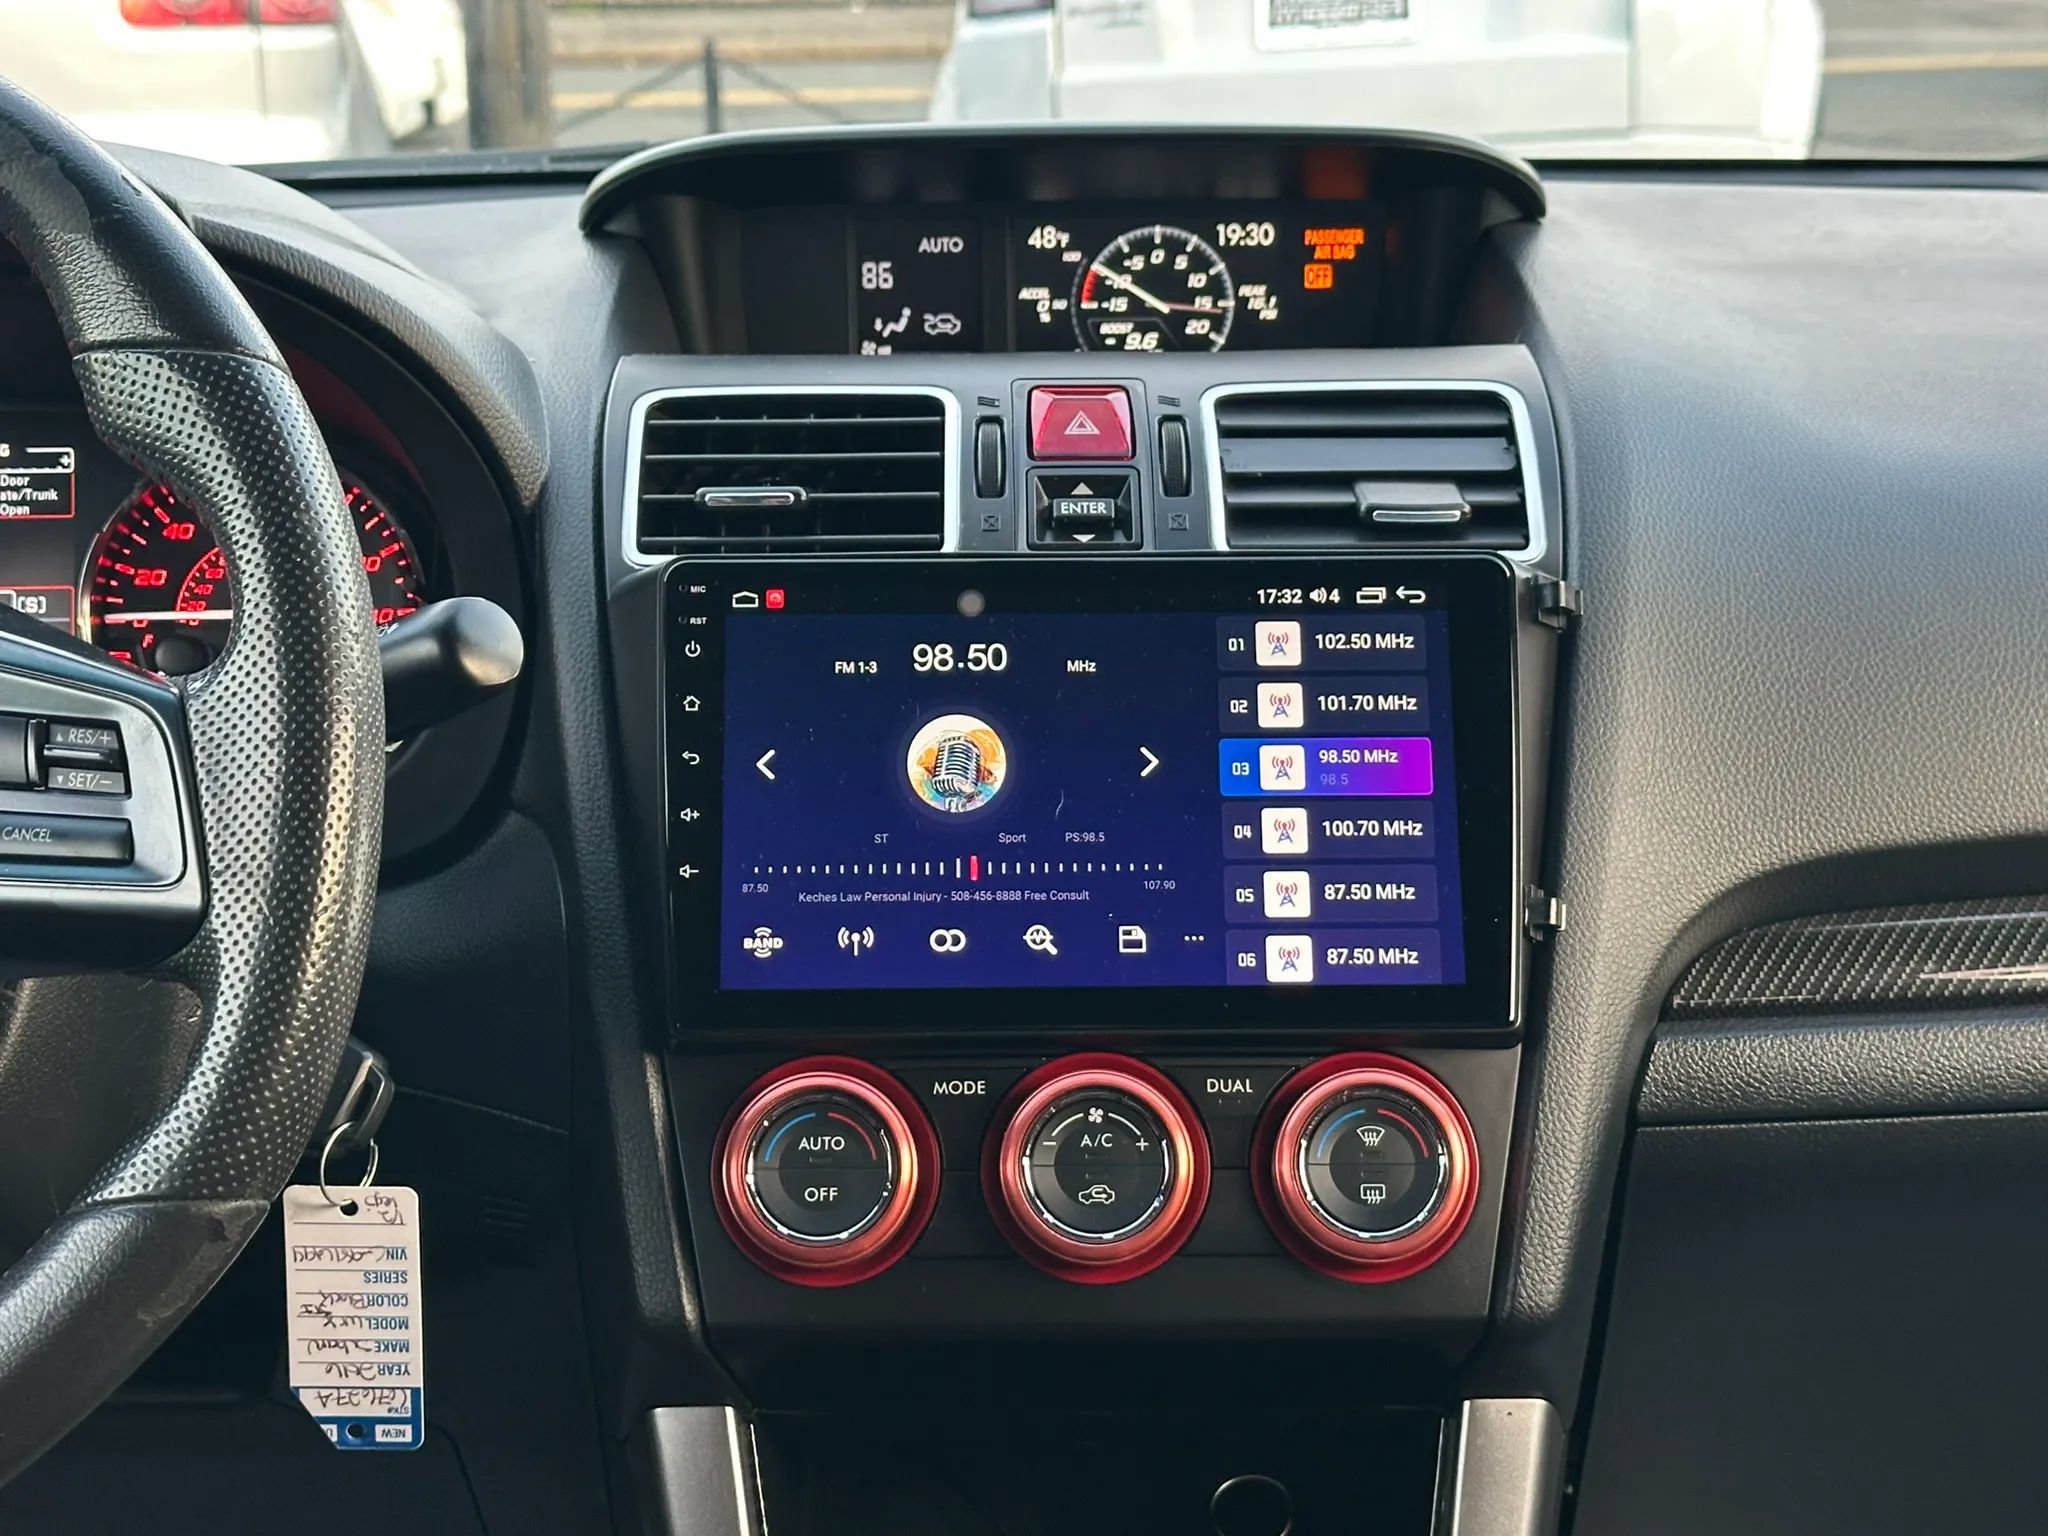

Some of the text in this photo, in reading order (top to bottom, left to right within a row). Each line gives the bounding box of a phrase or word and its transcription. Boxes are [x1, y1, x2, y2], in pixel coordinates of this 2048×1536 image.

[1216, 222, 1275, 246] 19:30
[1304, 228, 1365, 246] PASSENGER
[918, 236, 964, 253] AUTO
[1150, 248, 1165, 265] 0
[1314, 245, 1331, 260] AIR
[1123, 255, 1145, 270] -5
[1174, 254, 1189, 270] 5
[861, 261, 894, 289] 86
[1187, 273, 1207, 288] 10
[1305, 267, 1331, 287] OFF
[1238, 284, 1267, 297] PEAK
[1101, 297, 1128, 312] -15
[1194, 296, 1213, 310] 15
[1100, 322, 1134, 334] BOOST
[1185, 319, 1210, 335] 20
[1124, 332, 1160, 350] 9.6
[0, 475, 30, 487] Door
[0, 489, 58, 501] ate/Trunk
[0, 504, 30, 517] Open
[1060, 501, 1107, 514] ENTER
[163, 523, 195, 540] 40
[134, 569, 167, 586] 20
[194, 584, 213, 595] 40
[690, 585, 706, 593] MIC
[1257, 589, 1340, 604] 17:32 4
[690, 616, 707, 625] RST
[1228, 633, 1415, 651] 01 102.50 MHz
[912, 643, 1008, 672] 98.50
[834, 661, 878, 674] FM 1-3
[1066, 660, 1096, 673] MHz
[1230, 695, 1418, 713] 02 101.70 MHz
[1232, 750, 1399, 775] 03 98.50 MHz
[1320, 774, 1349, 785] 98.5
[2, 827, 52, 842] CANCEL
[1234, 820, 1423, 839] 04 100.70 MHz
[874, 834, 888, 844] ST
[998, 832, 1026, 844] Sport
[1065, 832, 1105, 843] PS:98.5
[742, 884, 769, 893] 87.50
[1143, 880, 1176, 890] 107.90
[799, 892, 837, 902] Keches
[840, 892, 861, 902] Law
[864, 891, 910, 901] Personal
[913, 891, 942, 903] Injury
[951, 890, 1022, 901] 508-456-8888
[1024, 890, 1047, 900] Free
[1050, 890, 1090, 900] Consult
[1236, 884, 1416, 902] 05 87.50 MHz
[743, 937, 784, 949] BAND
[1238, 948, 1419, 967] 06 87.50 MHz
[933, 1080, 986, 1095] MODE
[1207, 1078, 1253, 1093] DUAL
[799, 1136, 845, 1151] AUTO
[1080, 1134, 1113, 1148] A/C
[804, 1187, 838, 1202] OFF
[386, 1248, 407, 1260] VIN
[363, 1271, 408, 1284] SERIES
[367, 1293, 408, 1306] COLOR
[366, 1317, 408, 1330] MODEL
[374, 1340, 409, 1352] MAKE
[325, 1362, 410, 1381] YEAR 2016
[381, 1429, 406, 1438] NEW
